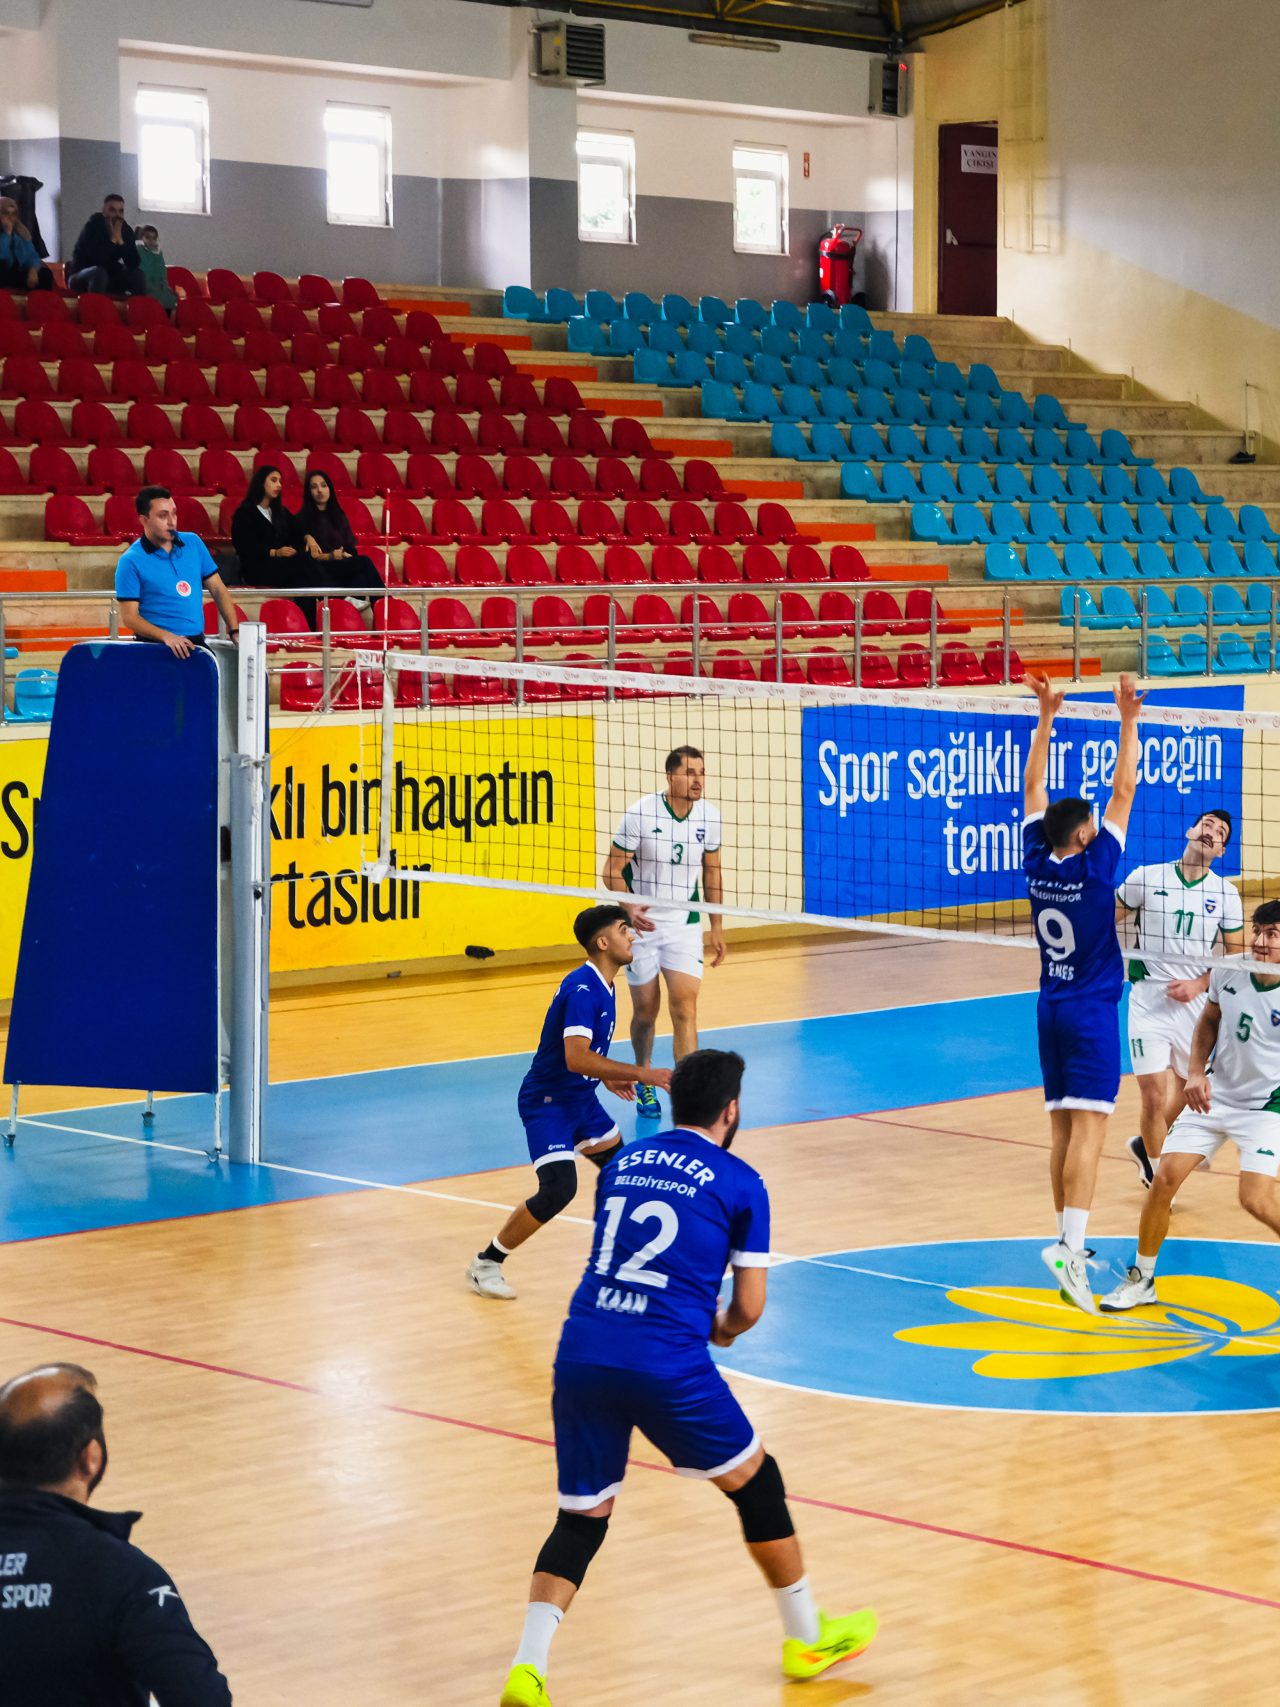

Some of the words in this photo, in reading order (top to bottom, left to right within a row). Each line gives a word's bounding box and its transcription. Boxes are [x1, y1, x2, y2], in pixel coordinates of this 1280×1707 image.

[818, 740, 898, 817] Spor
[907, 729, 1020, 809] sağlıklı
[1031, 728, 1073, 790] ir
[1079, 724, 1222, 800] geceğin
[321, 763, 382, 838] bir
[395, 760, 554, 843] hayatın
[671, 843, 685, 865] 3
[943, 807, 1024, 876] temi
[1037, 907, 1076, 961] 9
[1172, 908, 1195, 936] 11
[1235, 1011, 1254, 1042] 5
[1131, 1038, 1145, 1058] 11
[617, 1149, 715, 1187] ESENLER
[614, 1175, 697, 1198] BELEDİYESPOR
[594, 1196, 679, 1289] 12
[595, 1286, 649, 1315] KAAN
[0, 1552, 28, 1576] LER
[2, 1583, 52, 1609] SPOR
